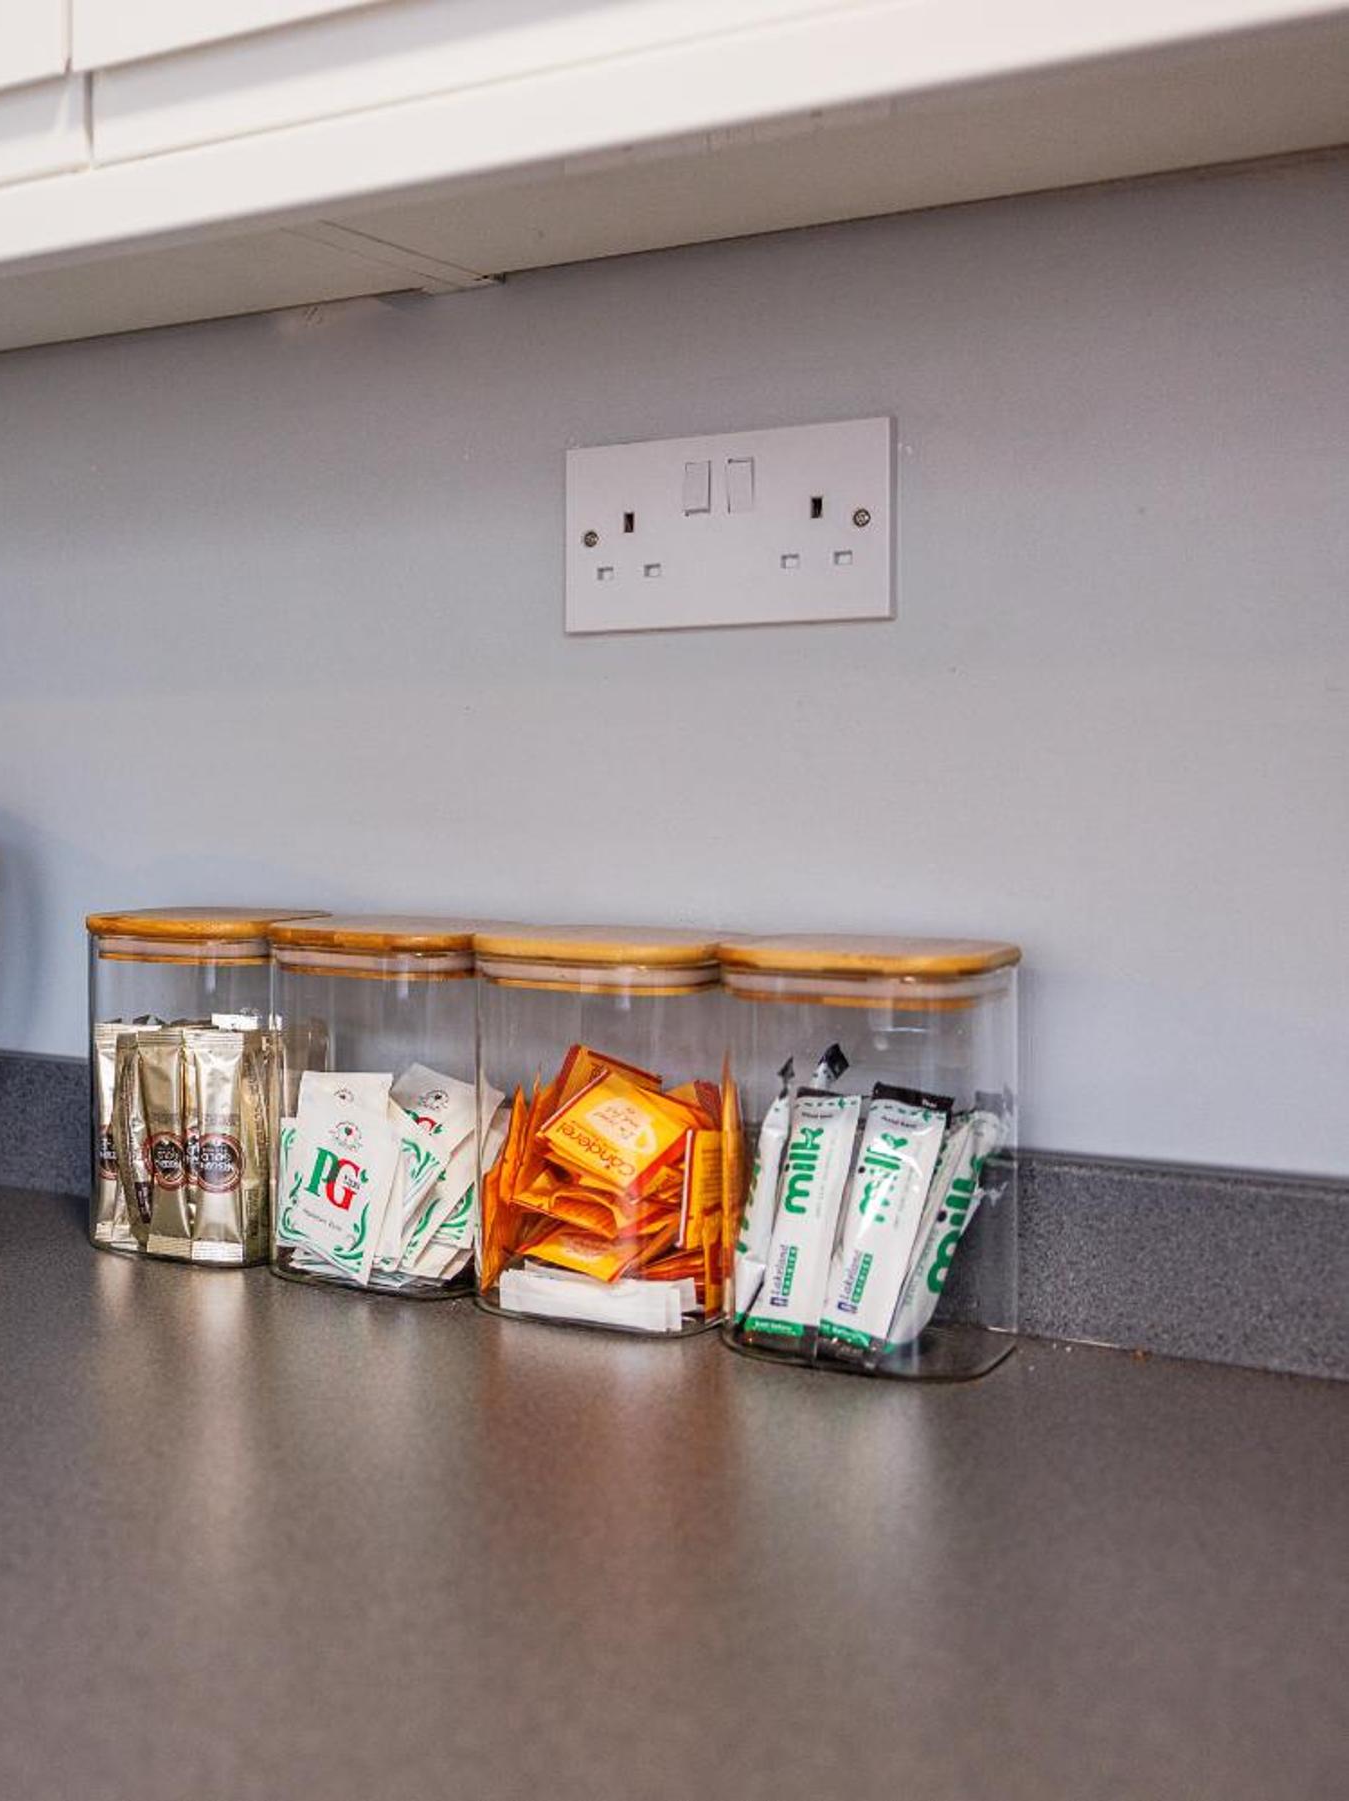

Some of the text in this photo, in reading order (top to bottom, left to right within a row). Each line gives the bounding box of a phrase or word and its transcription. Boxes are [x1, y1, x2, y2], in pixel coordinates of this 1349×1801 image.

[304, 1147, 360, 1212] PG
[556, 1121, 635, 1176] Canderel
[784, 1127, 824, 1214] milk
